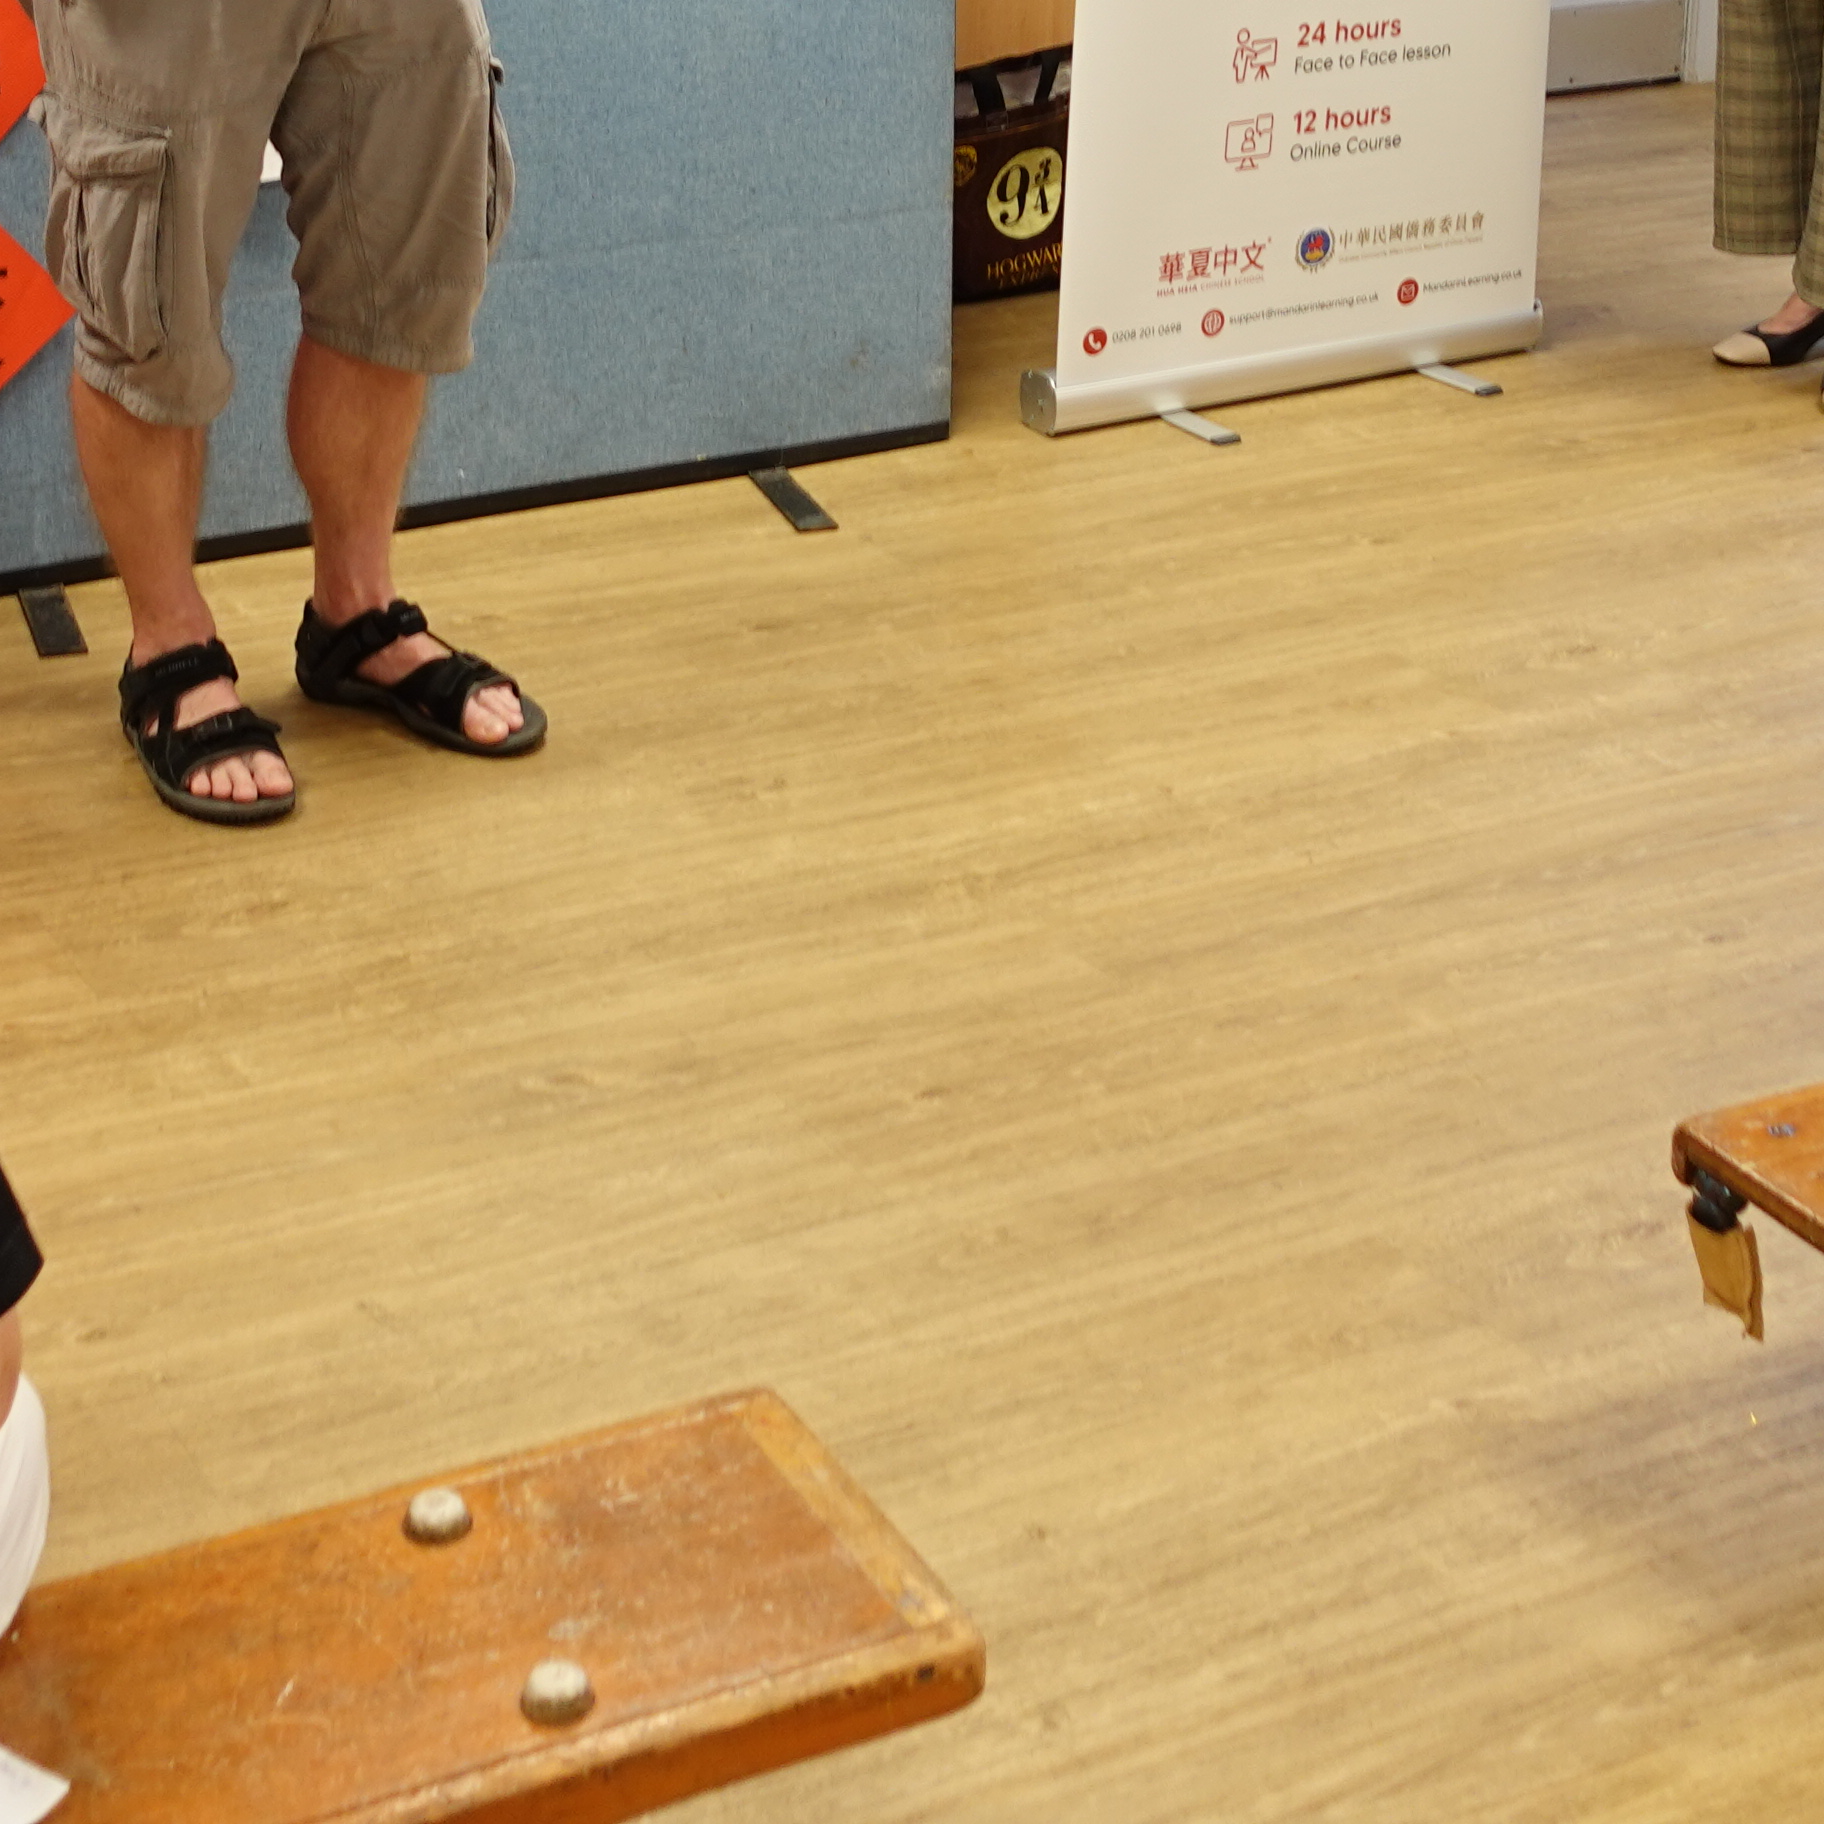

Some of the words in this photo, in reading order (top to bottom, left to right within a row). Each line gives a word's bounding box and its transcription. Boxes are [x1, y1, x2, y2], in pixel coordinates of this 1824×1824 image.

[1297, 20, 1326, 48] 24
[1335, 18, 1402, 44] hours
[1294, 54, 1334, 75] Face
[1339, 53, 1355, 70] to
[1359, 48, 1398, 67] Face
[1402, 42, 1452, 62] lesson
[1293, 109, 1317, 135] 12
[1325, 104, 1392, 132] hours
[1290, 140, 1341, 162] Online
[1346, 133, 1402, 155] Course
[1158, 239, 1267, 285] 華夏中文
